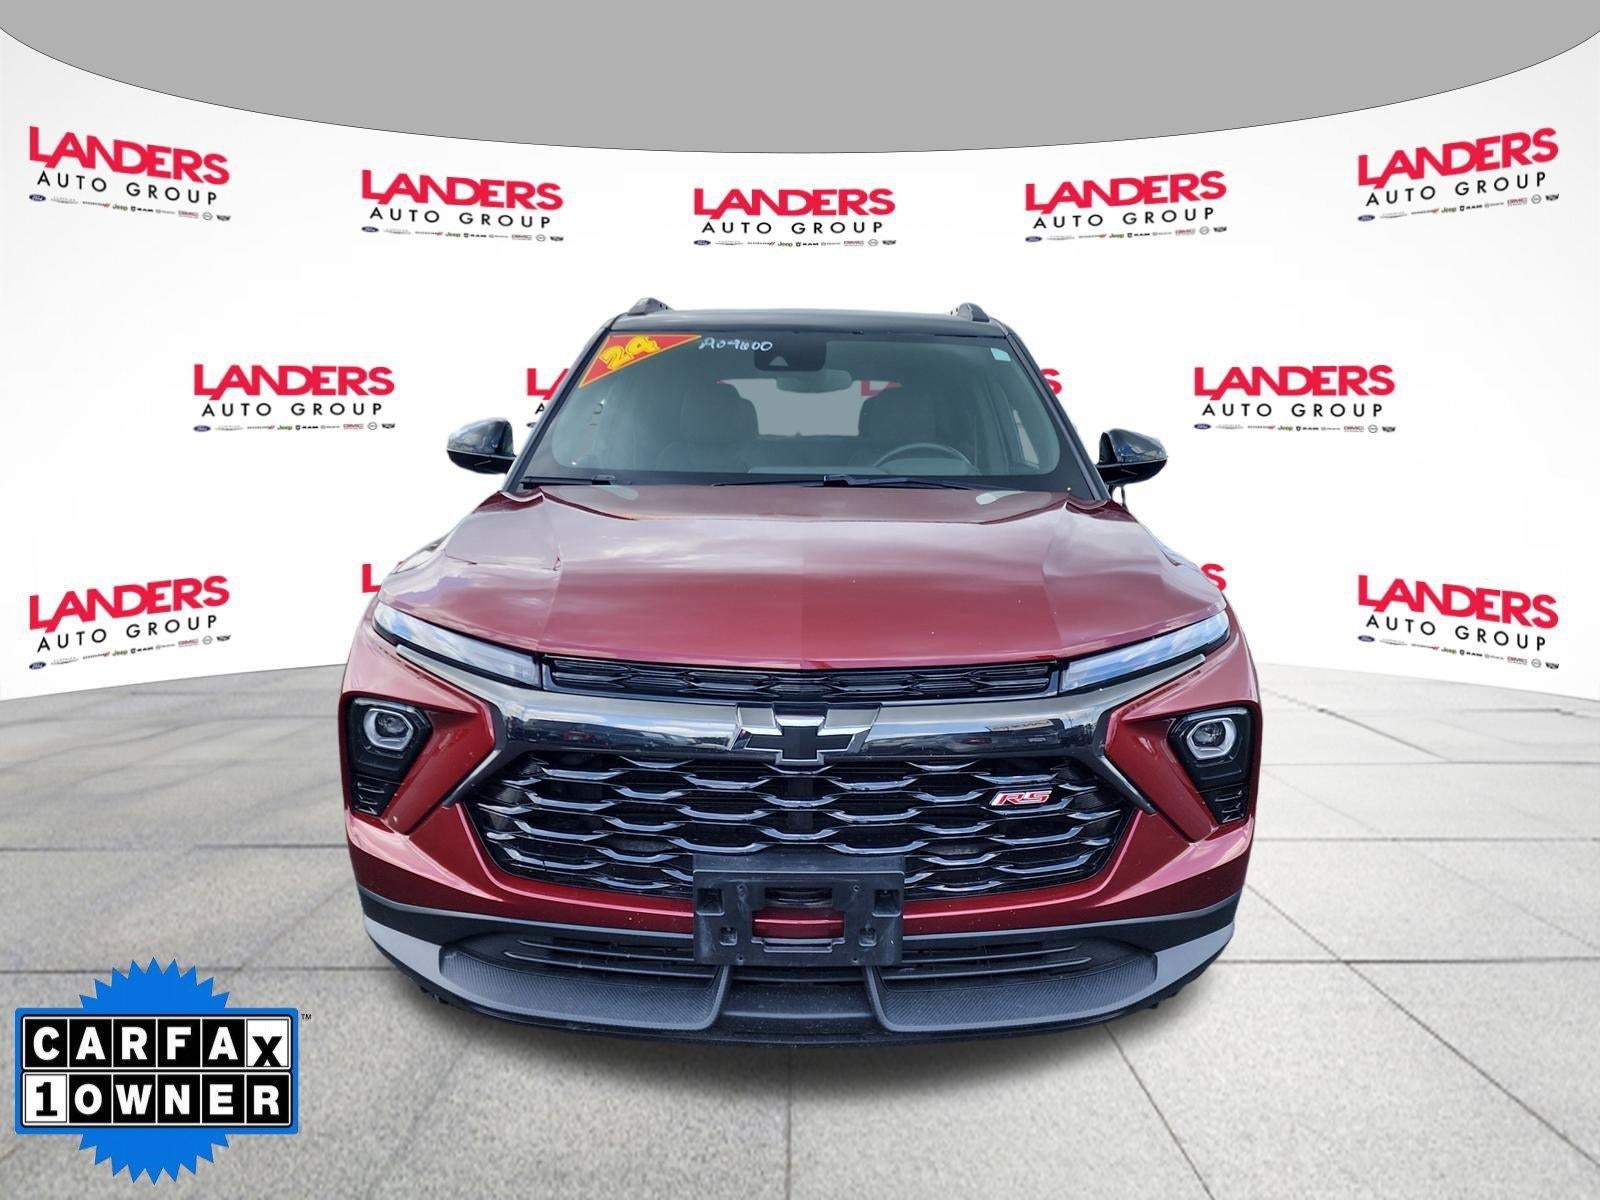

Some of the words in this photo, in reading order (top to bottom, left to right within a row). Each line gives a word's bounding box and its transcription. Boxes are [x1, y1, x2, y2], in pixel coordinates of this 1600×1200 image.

[29, 126, 230, 185] LANDERS
[1358, 128, 1559, 189] LANDERS
[38, 171, 106, 192] AUTO
[127, 183, 216, 204] GROUP
[362, 170, 563, 211] LANDERS
[694, 188, 895, 220] LANDERS
[1025, 171, 1226, 214] LANDERS
[1367, 186, 1435, 206] AUTO
[1455, 172, 1545, 195] GROUP
[370, 207, 439, 222] AUTO
[460, 213, 549, 228] GROUP
[702, 222, 771, 233] AUTO
[792, 222, 882, 234] GROUP
[1034, 215, 1103, 228] AUTO
[1123, 208, 1213, 224] GROUP
[194, 364, 394, 400] LANDERS
[1194, 365, 1395, 400] LANDERS
[202, 403, 271, 416] AUTO
[291, 403, 381, 415] GROUP
[1203, 404, 1271, 416] AUTO
[1292, 404, 1382, 417] GROUP
[29, 576, 230, 633] LANDERS
[1358, 575, 1558, 629] LANDERS
[38, 629, 106, 652] AUTO
[127, 615, 216, 638] GROUP
[1367, 615, 1435, 635] AUTO
[1455, 626, 1545, 650] GROUP
[990, 790, 1052, 806] RS
